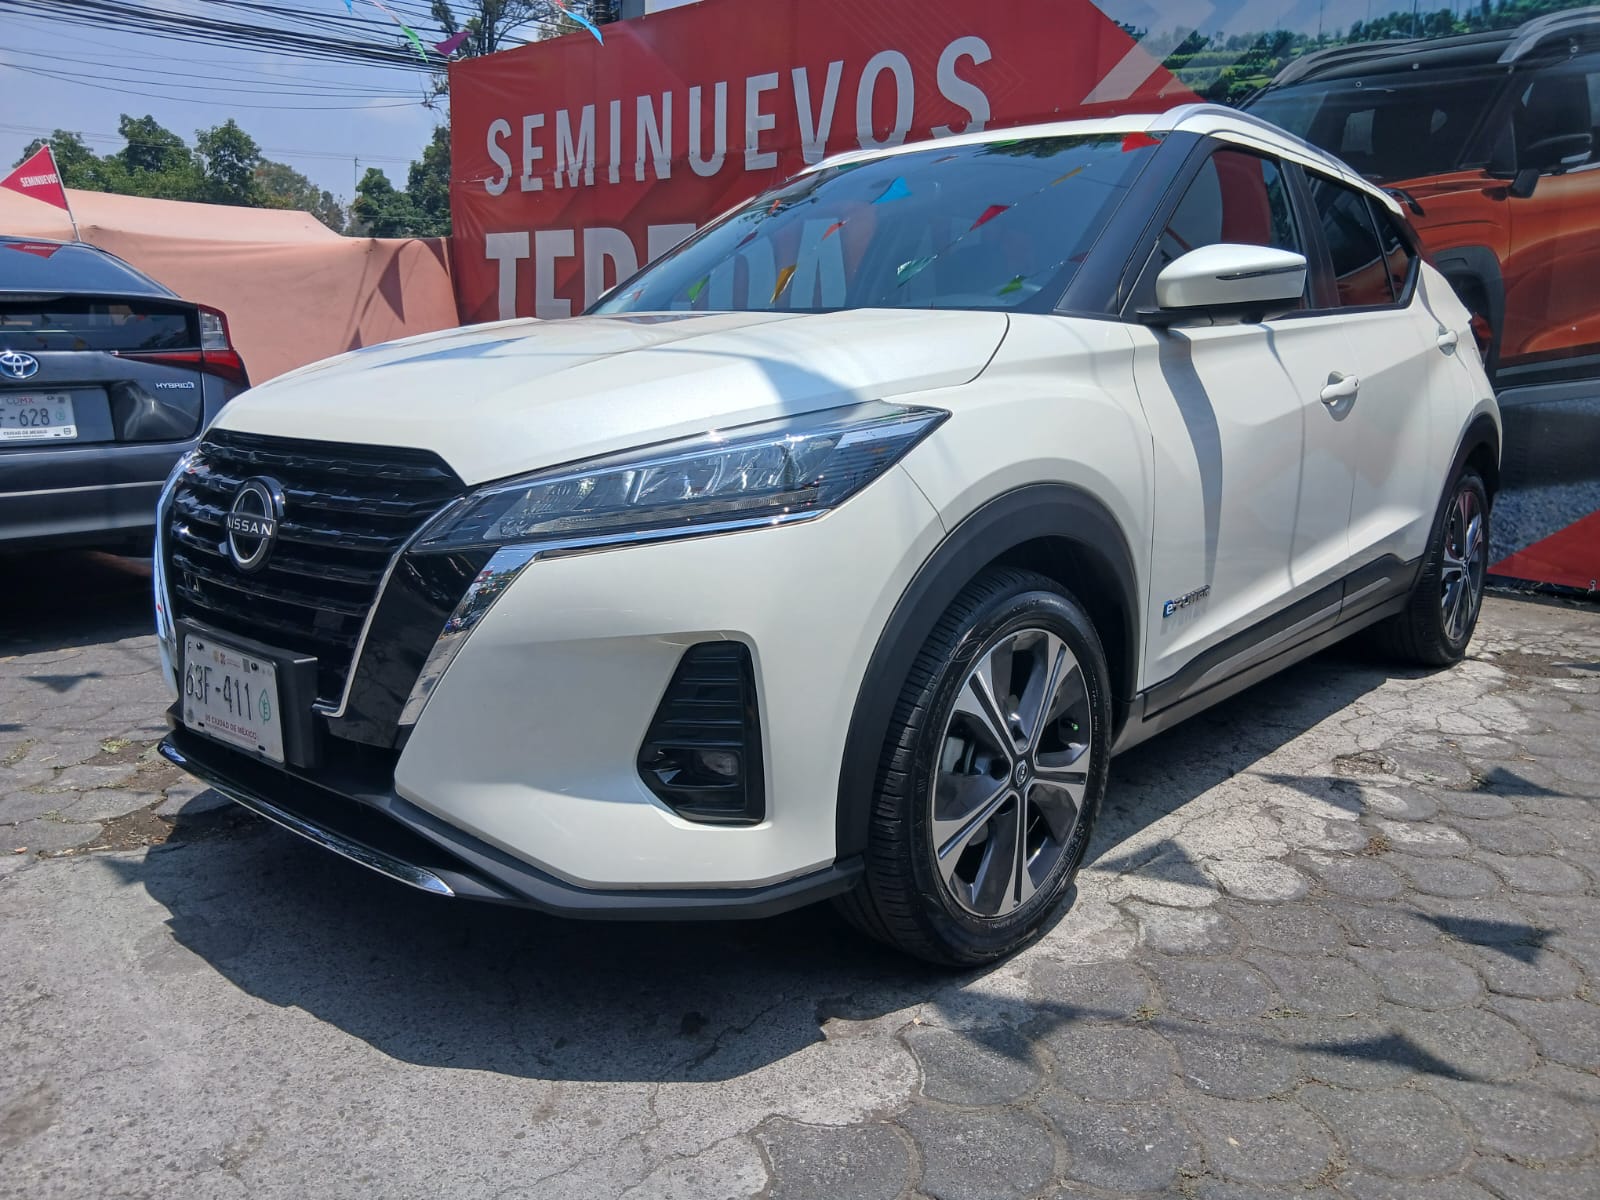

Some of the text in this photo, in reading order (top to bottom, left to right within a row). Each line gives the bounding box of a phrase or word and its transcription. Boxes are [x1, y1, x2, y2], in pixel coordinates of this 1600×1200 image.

[485, 35, 992, 196] SEMINUEVOS
[20, 173, 58, 188] SEMINUEVOS
[155, 382, 192, 390] HYBRID
[227, 515, 273, 536] NISSAN
[185, 661, 252, 721] 63F-411
